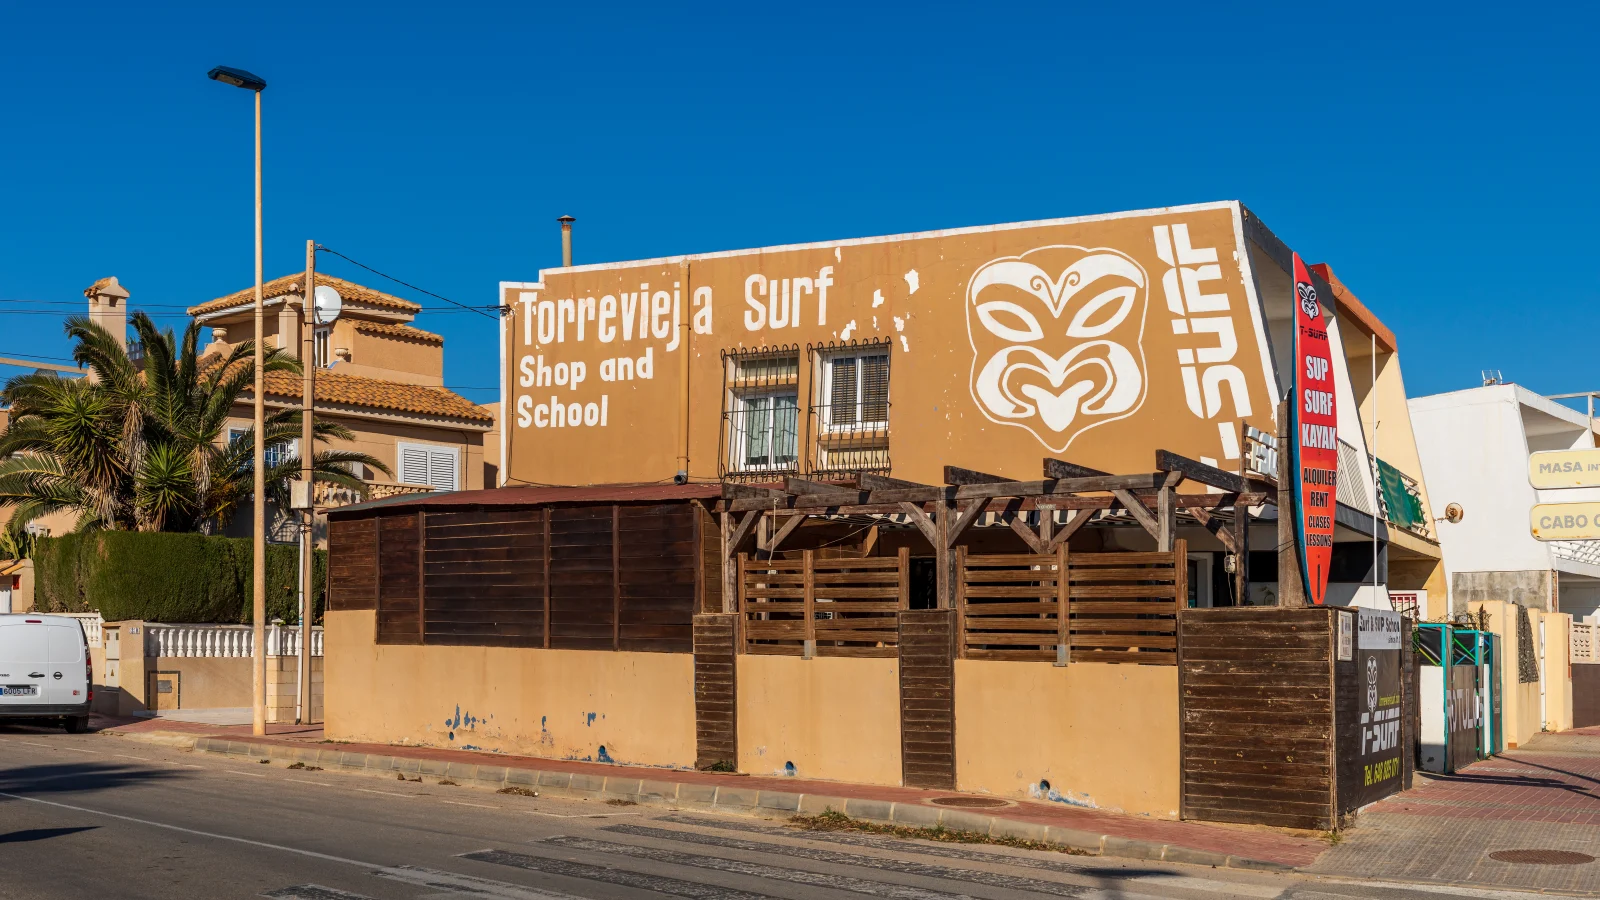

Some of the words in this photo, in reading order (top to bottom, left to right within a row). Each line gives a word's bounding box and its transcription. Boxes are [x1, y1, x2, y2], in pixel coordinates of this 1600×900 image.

[744, 265, 834, 331] Surf
[1299, 325, 1329, 341] T-SURF
[519, 355, 587, 391] Shop
[600, 347, 654, 382] and
[1305, 355, 1329, 382] SUP
[517, 395, 609, 428] School
[1304, 388, 1333, 416] SURF
[1302, 422, 1337, 451] KAYAK
[1304, 467, 1337, 487] ALQUILER
[1539, 461, 1583, 474] MASA
[1310, 491, 1329, 508] RENT
[1308, 515, 1331, 529] CLASES
[1540, 514, 1588, 530] CABO
[1306, 533, 1332, 548] LESSONS
[1360, 707, 1400, 756] T-SURF
